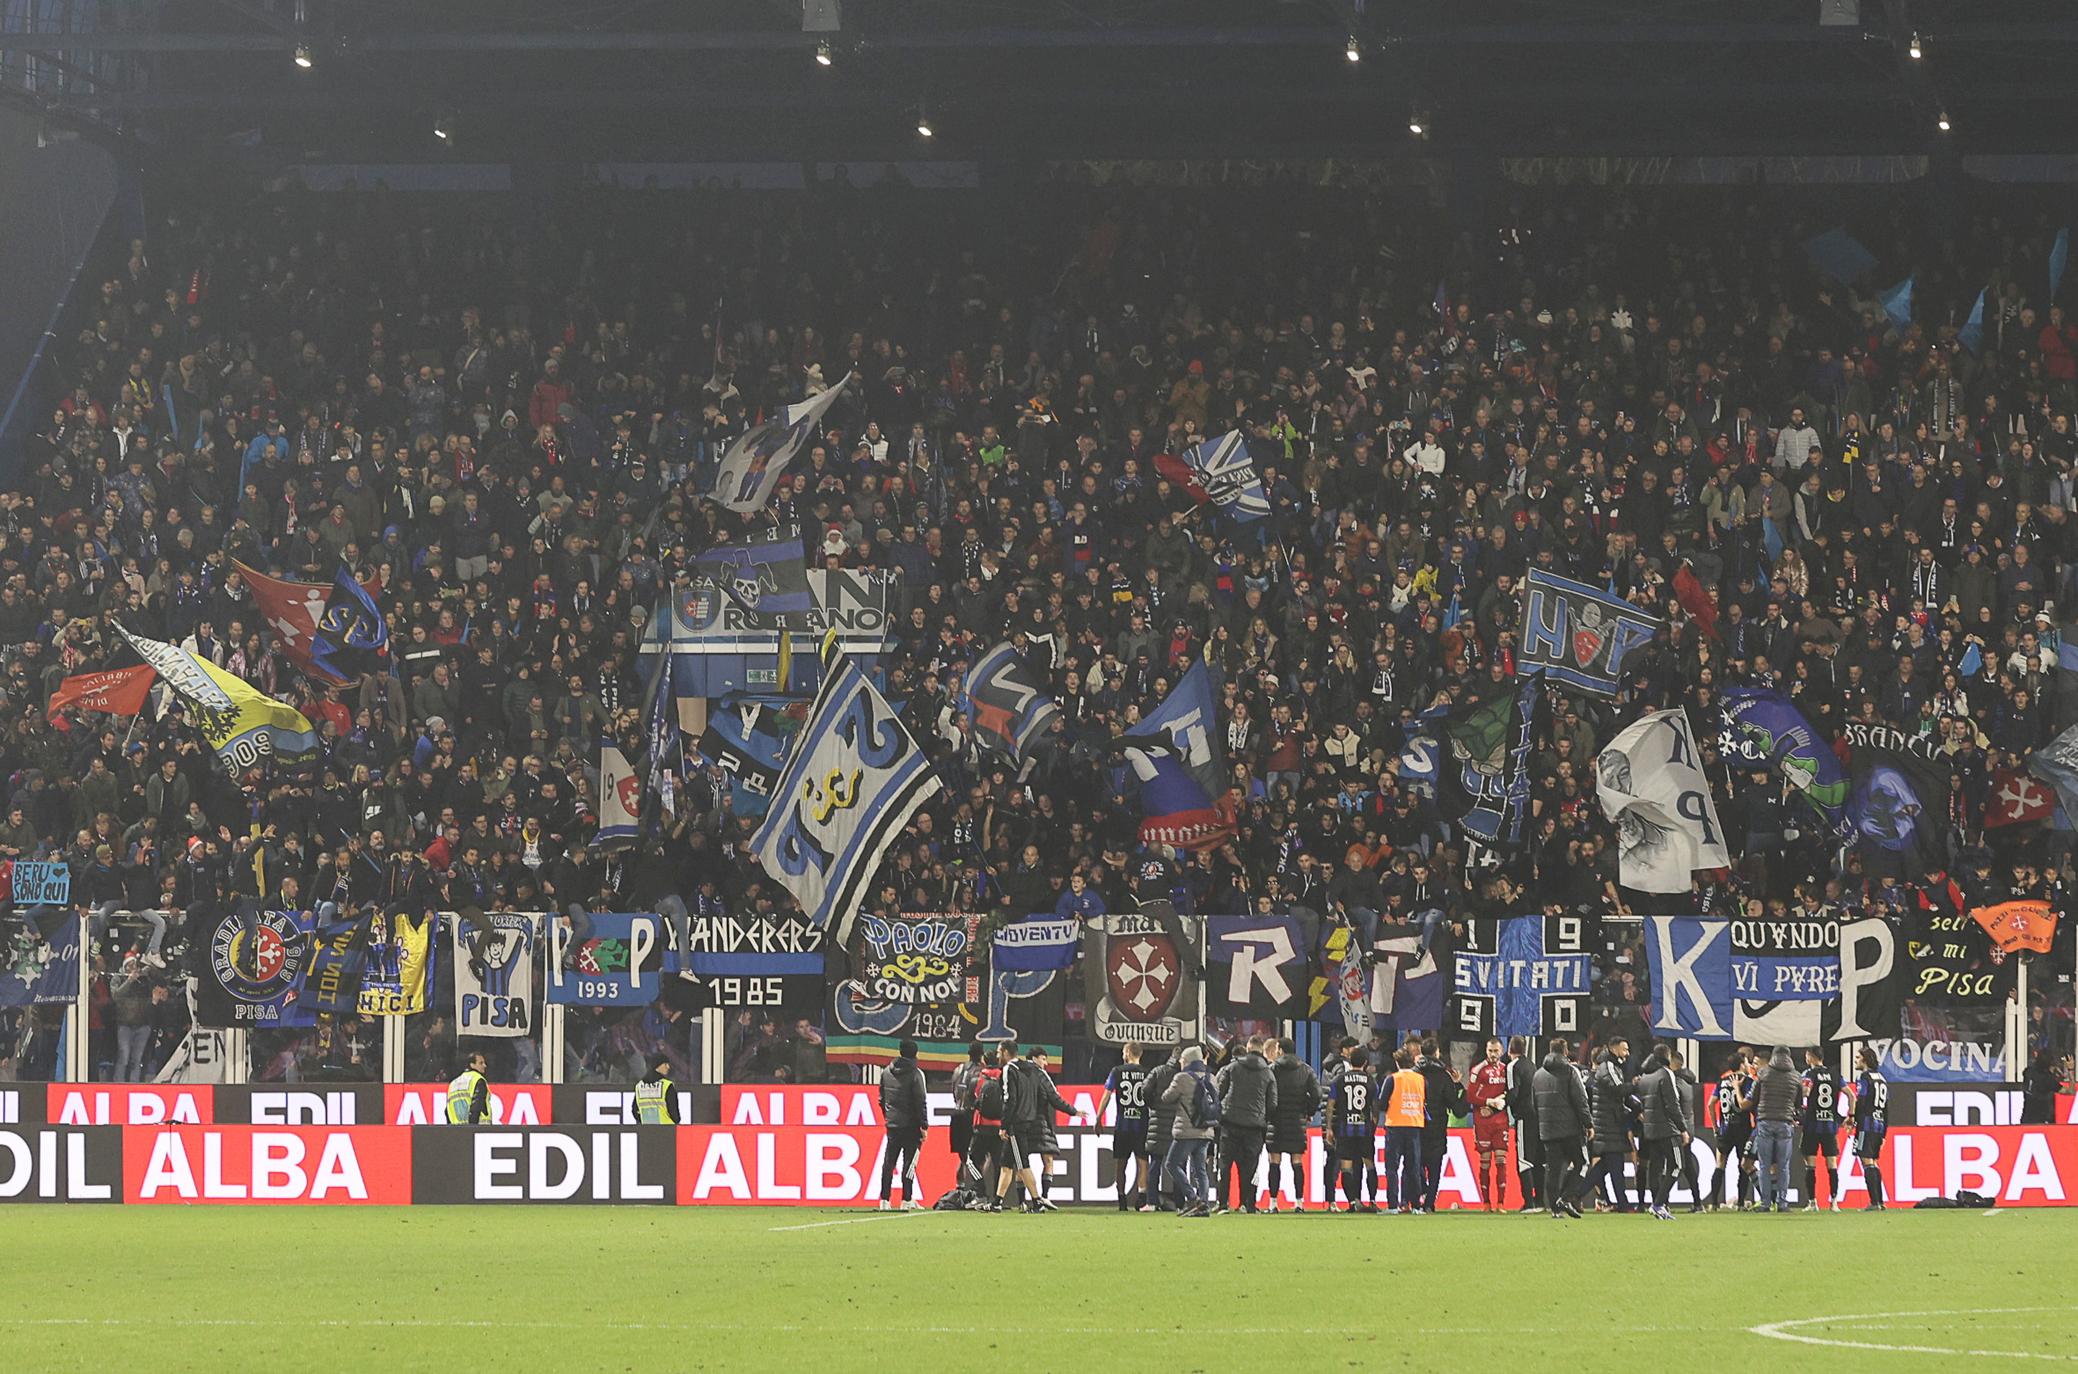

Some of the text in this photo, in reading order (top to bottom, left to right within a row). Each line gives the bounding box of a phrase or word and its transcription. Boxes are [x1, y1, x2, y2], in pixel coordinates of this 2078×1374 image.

[1454, 957, 1582, 989] SVITATI
[578, 980, 619, 998] 1993
[708, 977, 783, 1005] 1985
[874, 977, 915, 1003] CON
[235, 1004, 279, 1019] PISA
[461, 993, 528, 1029] PISA
[1343, 1084, 1367, 1110] 18
[1817, 1083, 1833, 1108] 8
[139, 1132, 369, 1200] ALBA
[474, 1132, 664, 1200] EDIL
